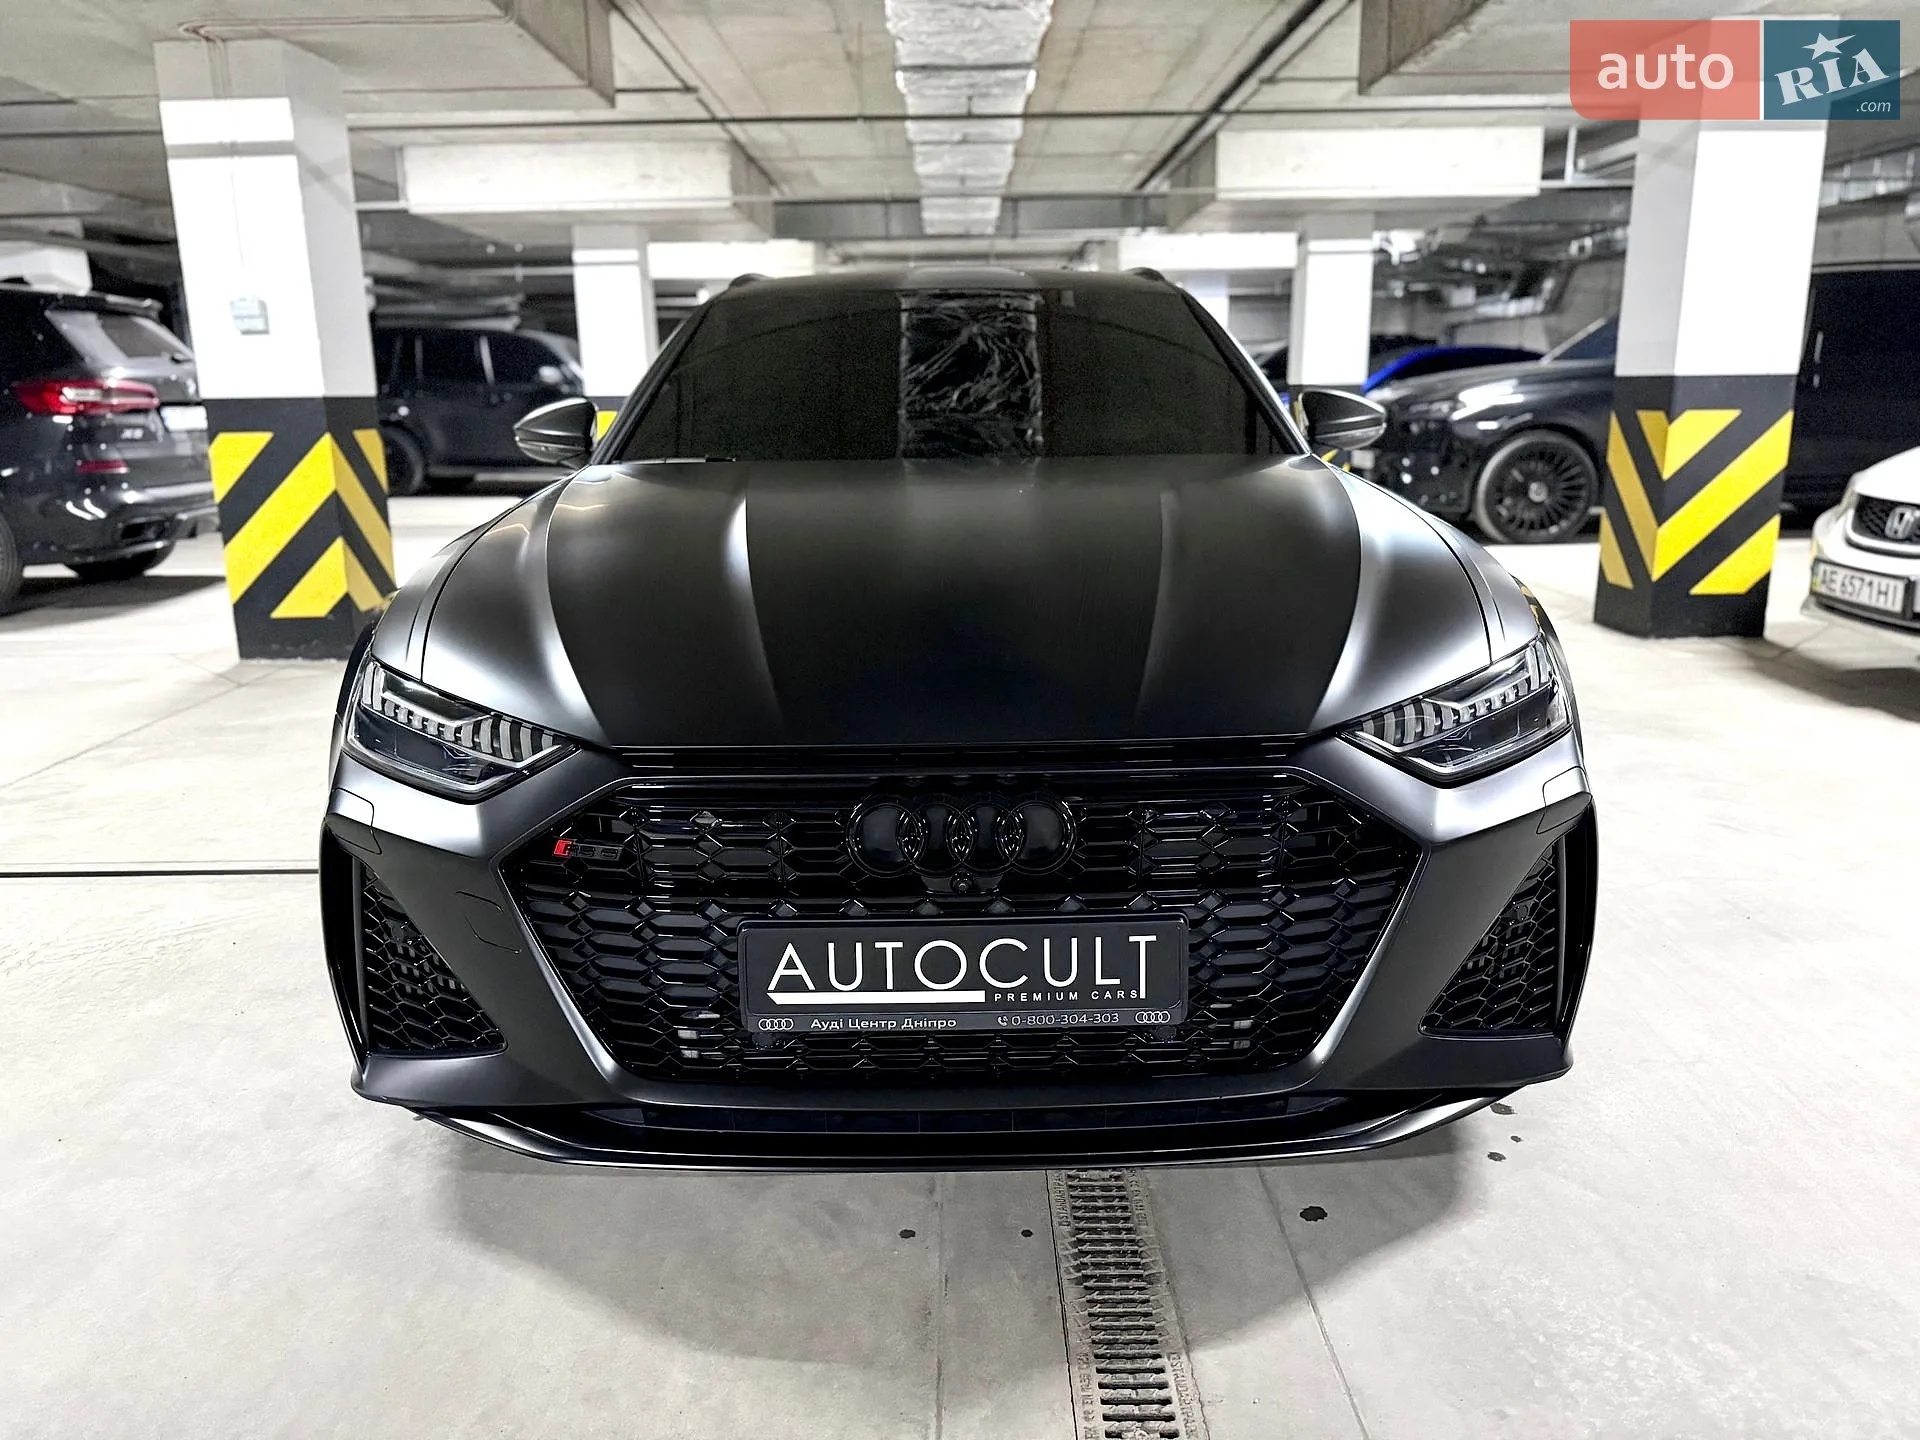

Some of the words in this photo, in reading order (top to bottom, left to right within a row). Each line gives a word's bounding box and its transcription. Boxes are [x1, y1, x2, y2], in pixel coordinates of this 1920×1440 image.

[767, 935, 1158, 999] AUTOCULT
[994, 991, 1079, 1003] PREMIUM
[1091, 989, 1138, 1001] CARS
[810, 1016, 844, 1030] Ауді
[848, 1017, 897, 1030] Центр
[901, 1016, 957, 1030] Дніпро
[1011, 1012, 1119, 1026] 0-800-304-303
